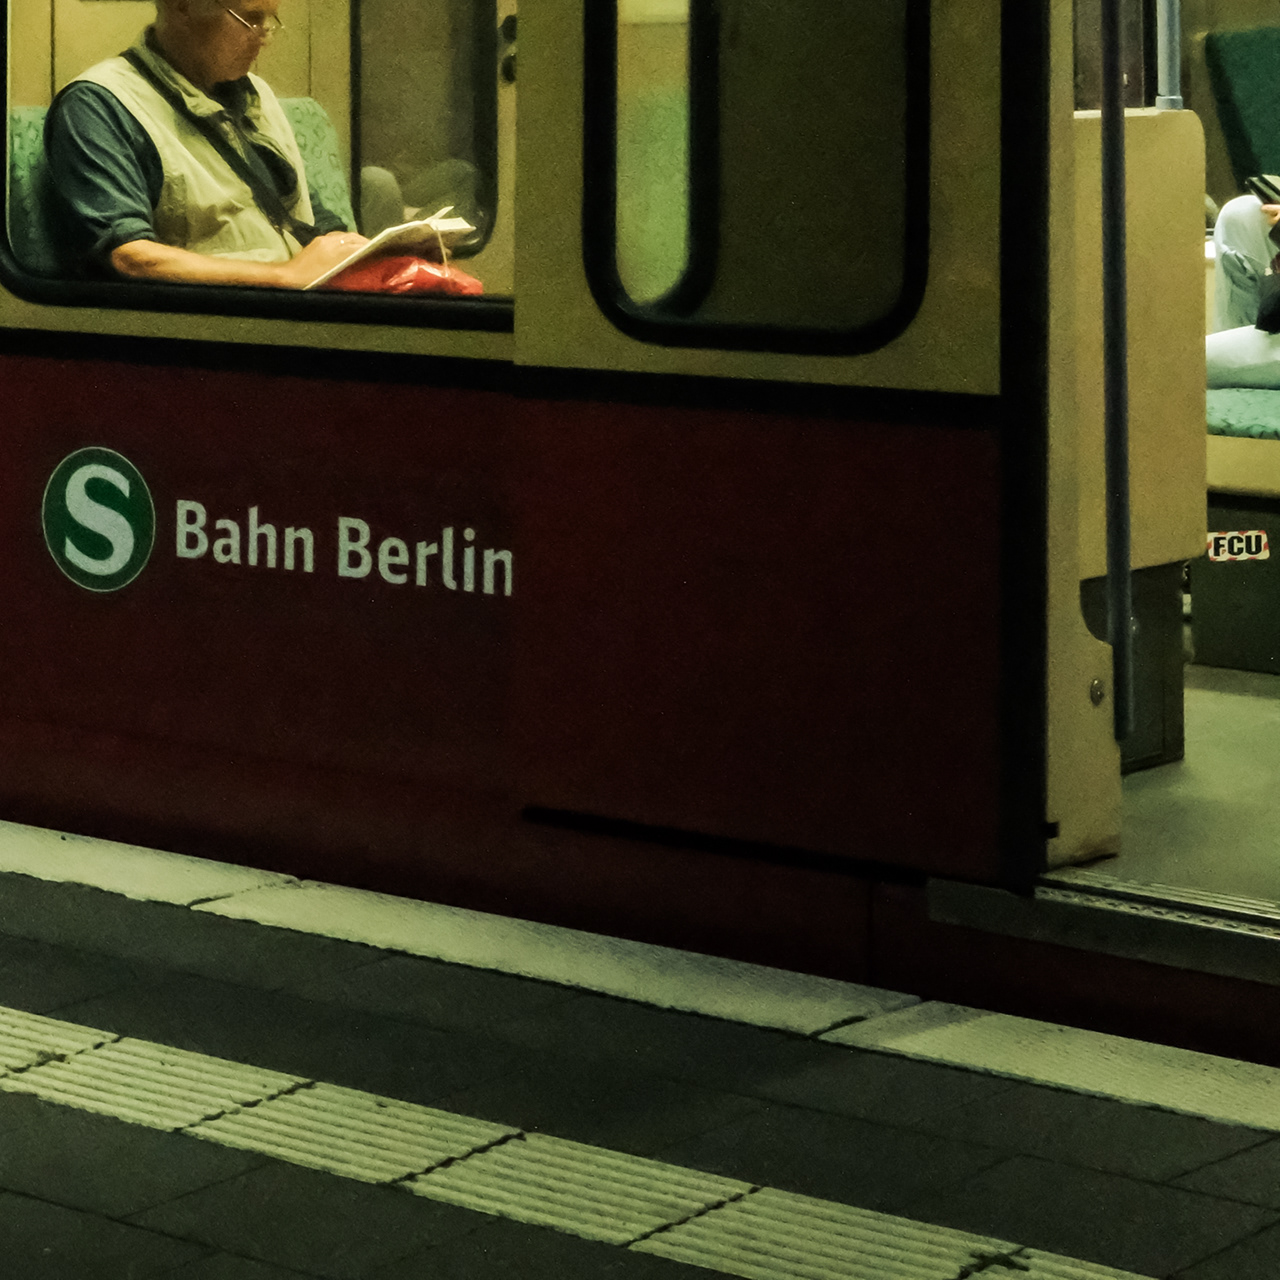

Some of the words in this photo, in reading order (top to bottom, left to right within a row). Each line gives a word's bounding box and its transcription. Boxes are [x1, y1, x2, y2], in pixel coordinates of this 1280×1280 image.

[175, 498, 315, 573] Bahn
[337, 515, 514, 597] Berlin
[1213, 534, 1263, 557] FCU
